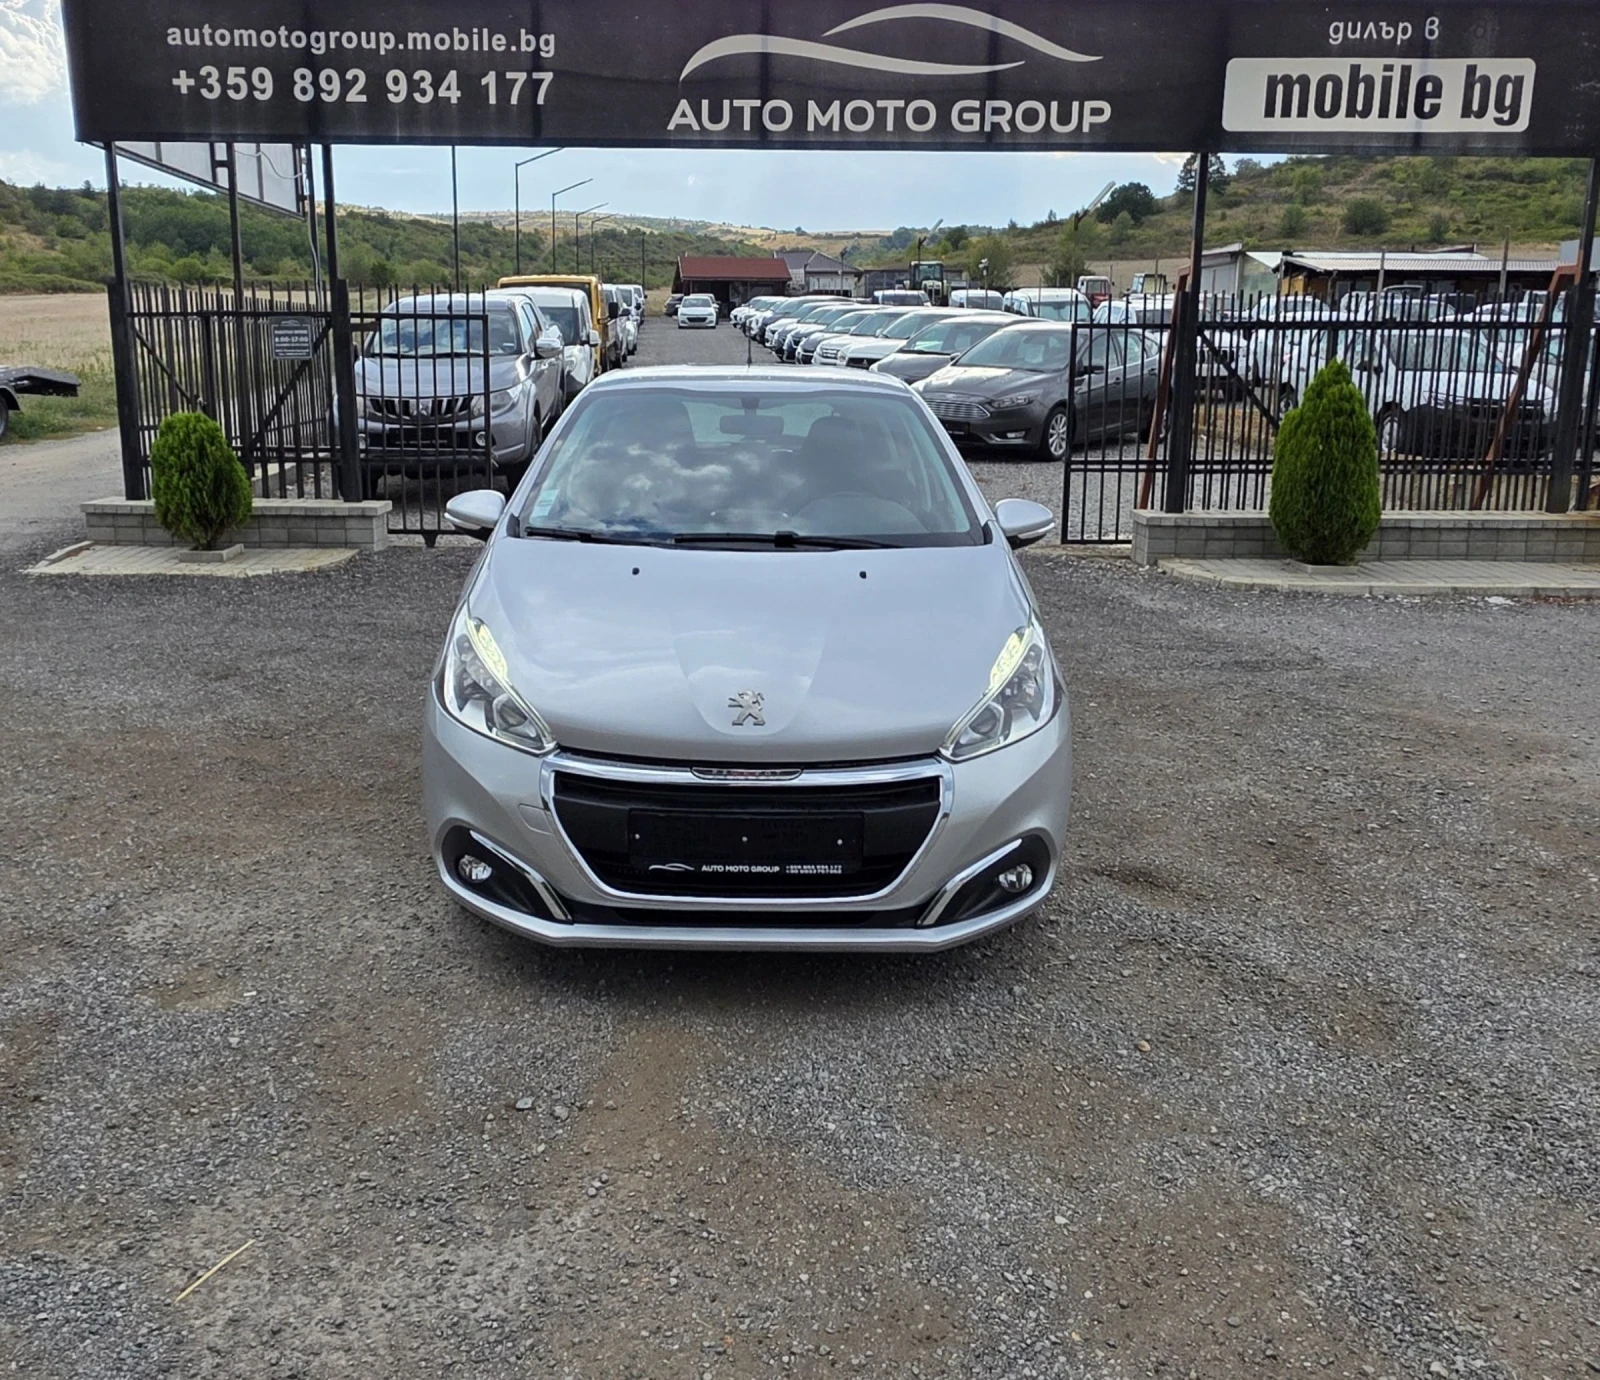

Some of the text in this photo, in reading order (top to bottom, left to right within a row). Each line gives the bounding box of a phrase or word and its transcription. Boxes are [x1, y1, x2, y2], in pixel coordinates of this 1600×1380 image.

[166, 24, 556, 57] automotogroup.mobile.bg
[1328, 16, 1440, 46] дилър в
[171, 65, 554, 106] +359 892 934 177
[1263, 63, 1526, 127] mobile bg
[666, 98, 1112, 134] AUTO MOTO GROUP
[750, 865, 780, 873] GROUP
